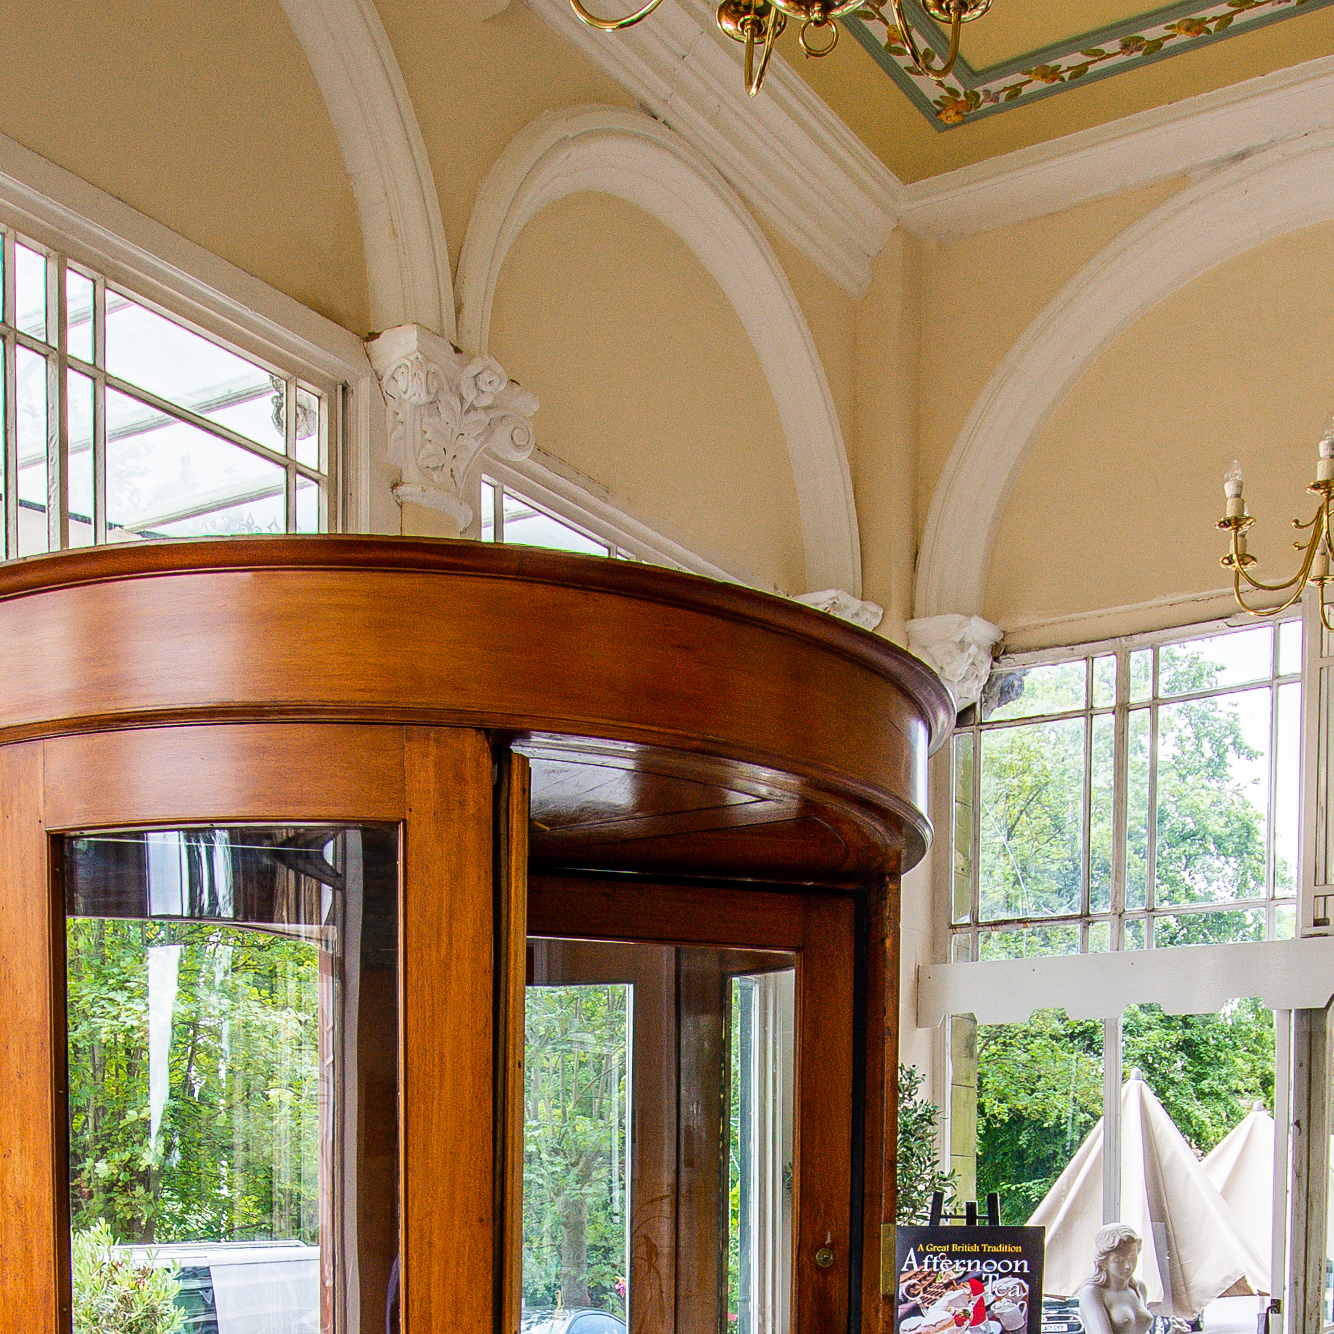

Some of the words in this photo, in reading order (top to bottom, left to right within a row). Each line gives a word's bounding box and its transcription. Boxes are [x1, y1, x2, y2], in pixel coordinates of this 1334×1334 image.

[901, 1248, 1030, 1273] Afternoon
[918, 1244, 924, 1252] A
[926, 1244, 949, 1252] Great
[952, 1244, 979, 1252] British
[982, 1244, 1022, 1253] Tradition
[982, 1273, 1022, 1297] Tea
